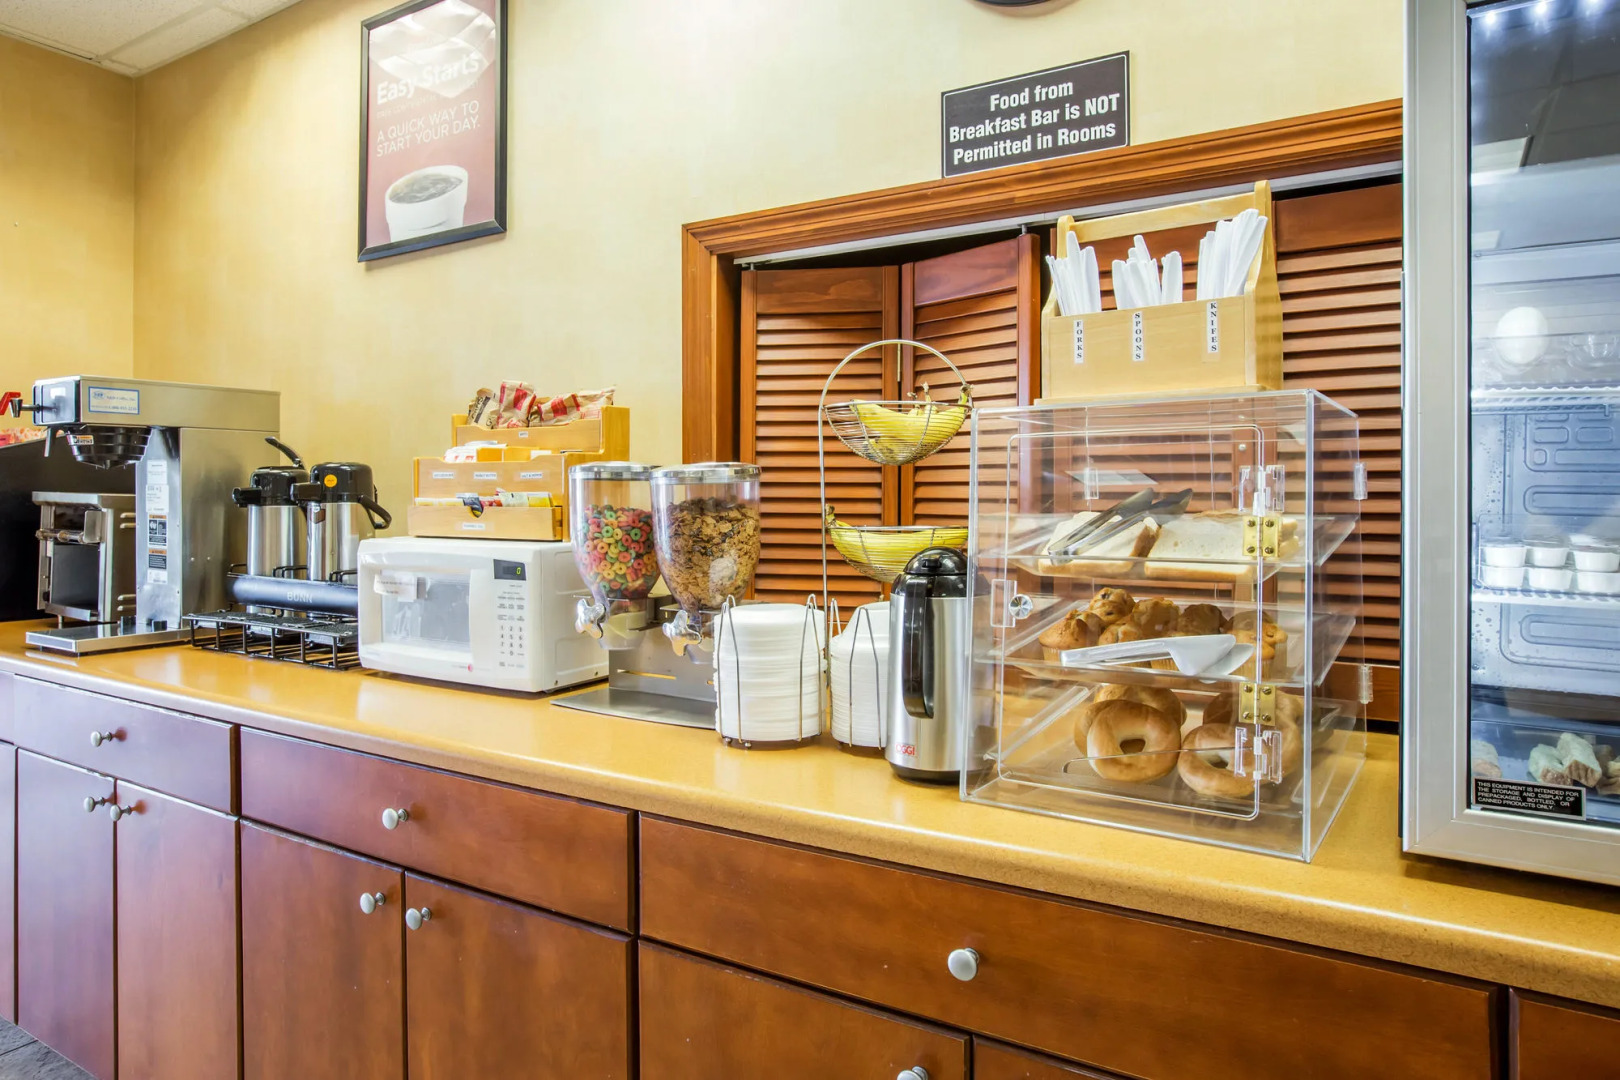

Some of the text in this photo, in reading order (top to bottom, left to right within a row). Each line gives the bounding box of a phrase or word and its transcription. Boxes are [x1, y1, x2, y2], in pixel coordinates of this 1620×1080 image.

[377, 53, 480, 105] Easy Starts
[990, 82, 1073, 111] Food from
[377, 100, 480, 142] A QUICK WAY TO
[949, 94, 1120, 143] Breakfast Bar is NOT
[377, 115, 480, 157] START YOUR DAY.
[953, 123, 1116, 165] Permitted in Rooms
[1134, 312, 1142, 360] SPOONS
[1210, 302, 1218, 352] KNIFES
[517, 567, 522, 575] 0
[287, 592, 313, 603] BUNN
[896, 744, 915, 755] OGGI
[1478, 792, 1522, 802] PREPACKAGED,
[1526, 797, 1556, 806] BOTTLED,
[1492, 783, 1526, 791] EQUIPMENT
[1534, 787, 1564, 796] INTENDED
[1492, 788, 1520, 796] STORAGE
[1538, 793, 1563, 801] DISPLAY
[1503, 800, 1535, 808] PRODUCTS
